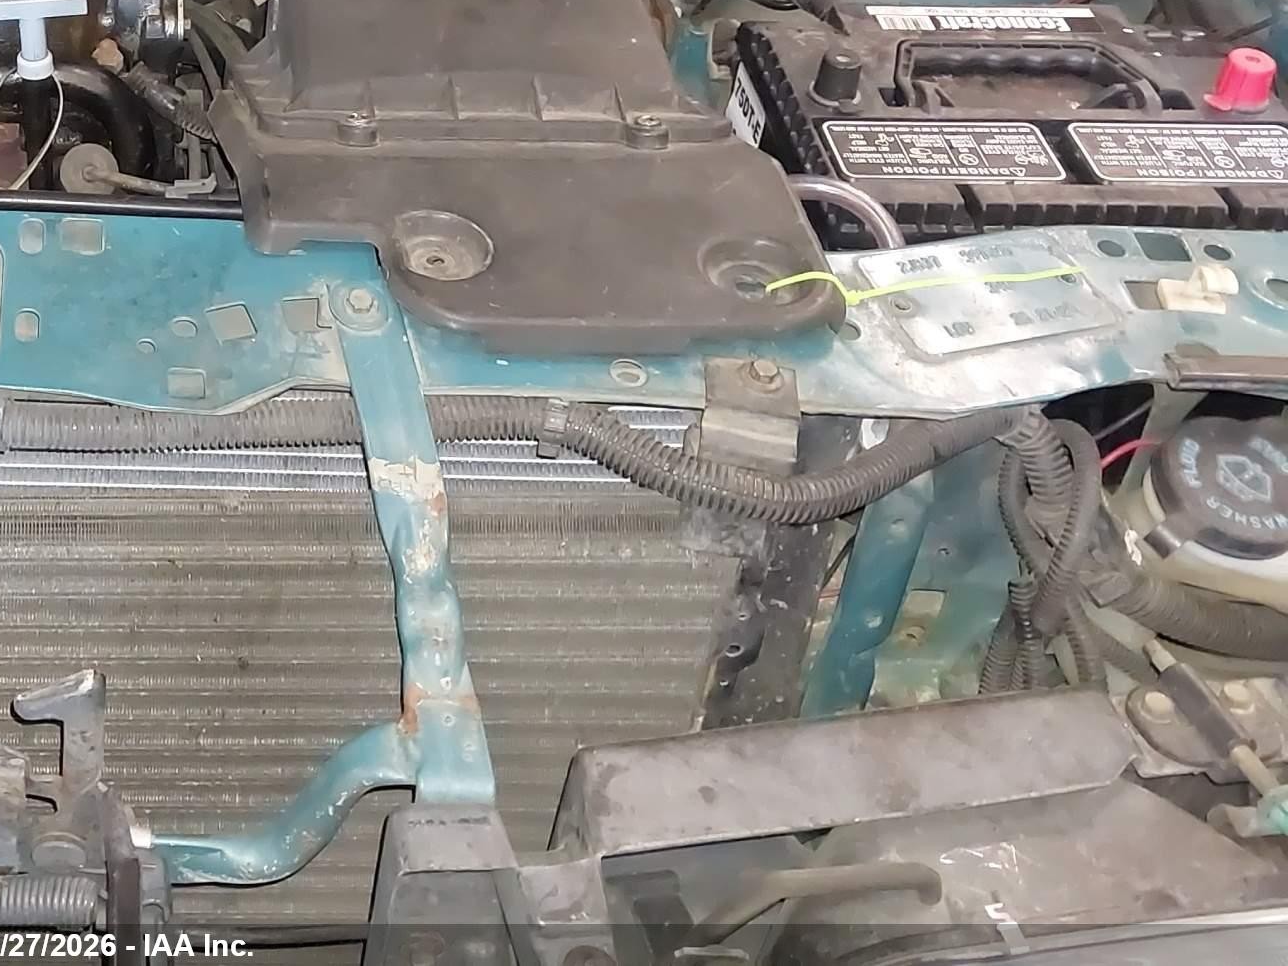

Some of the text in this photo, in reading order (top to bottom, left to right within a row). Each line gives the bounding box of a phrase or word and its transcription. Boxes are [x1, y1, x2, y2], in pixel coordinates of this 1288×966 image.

[936, 15, 1072, 32] Econocraft
[735, 77, 761, 144] 75DT-E
[1180, 438, 1203, 489] FLUID
[1206, 496, 1288, 529] WASHER
